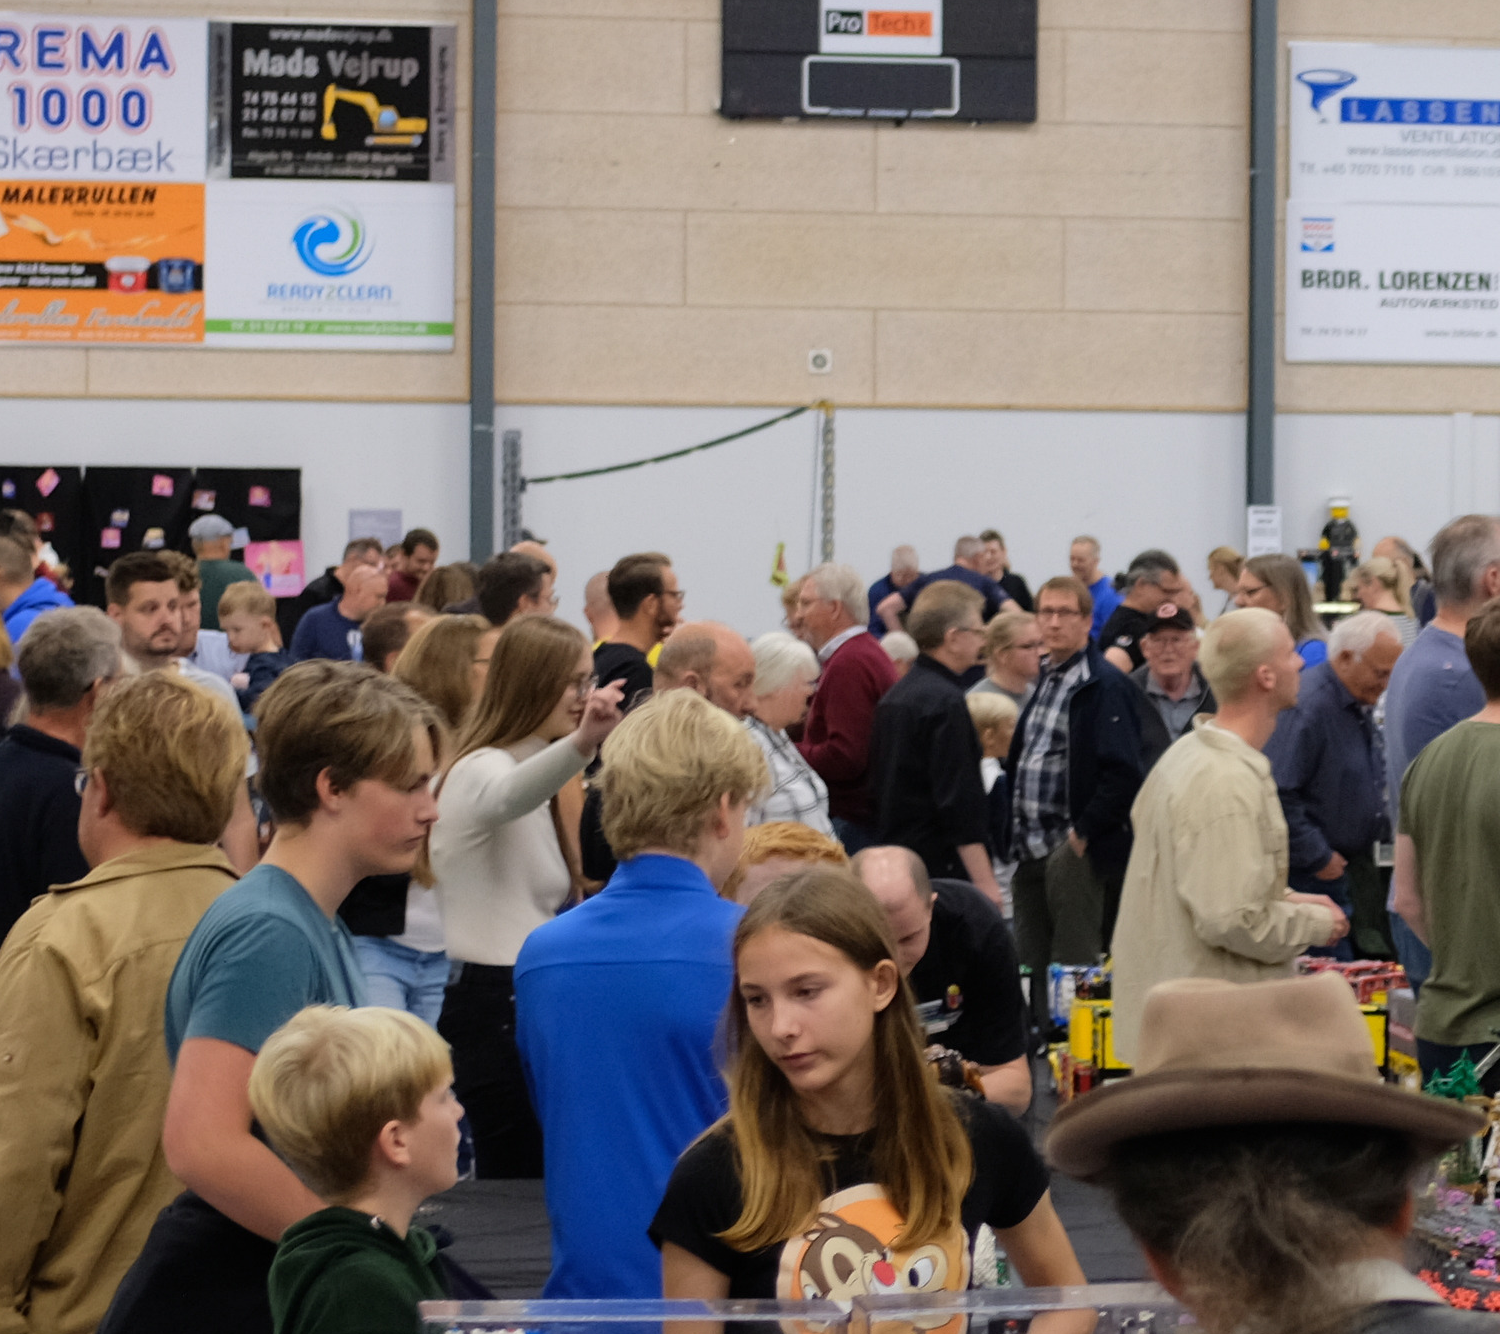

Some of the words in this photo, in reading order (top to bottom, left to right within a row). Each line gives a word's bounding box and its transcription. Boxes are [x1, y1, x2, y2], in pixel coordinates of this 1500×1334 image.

[827, 12, 861, 33] Pro
[242, 47, 320, 78] Mads
[326, 49, 420, 87] Vejrup
[9, 83, 152, 131] 1000
[1349, 100, 1500, 124] LASSEN
[1, 185, 158, 205] MALERRULLEN
[266, 283, 393, 301] READY2CLEAN
[1378, 270, 1493, 292] LORENZEN
